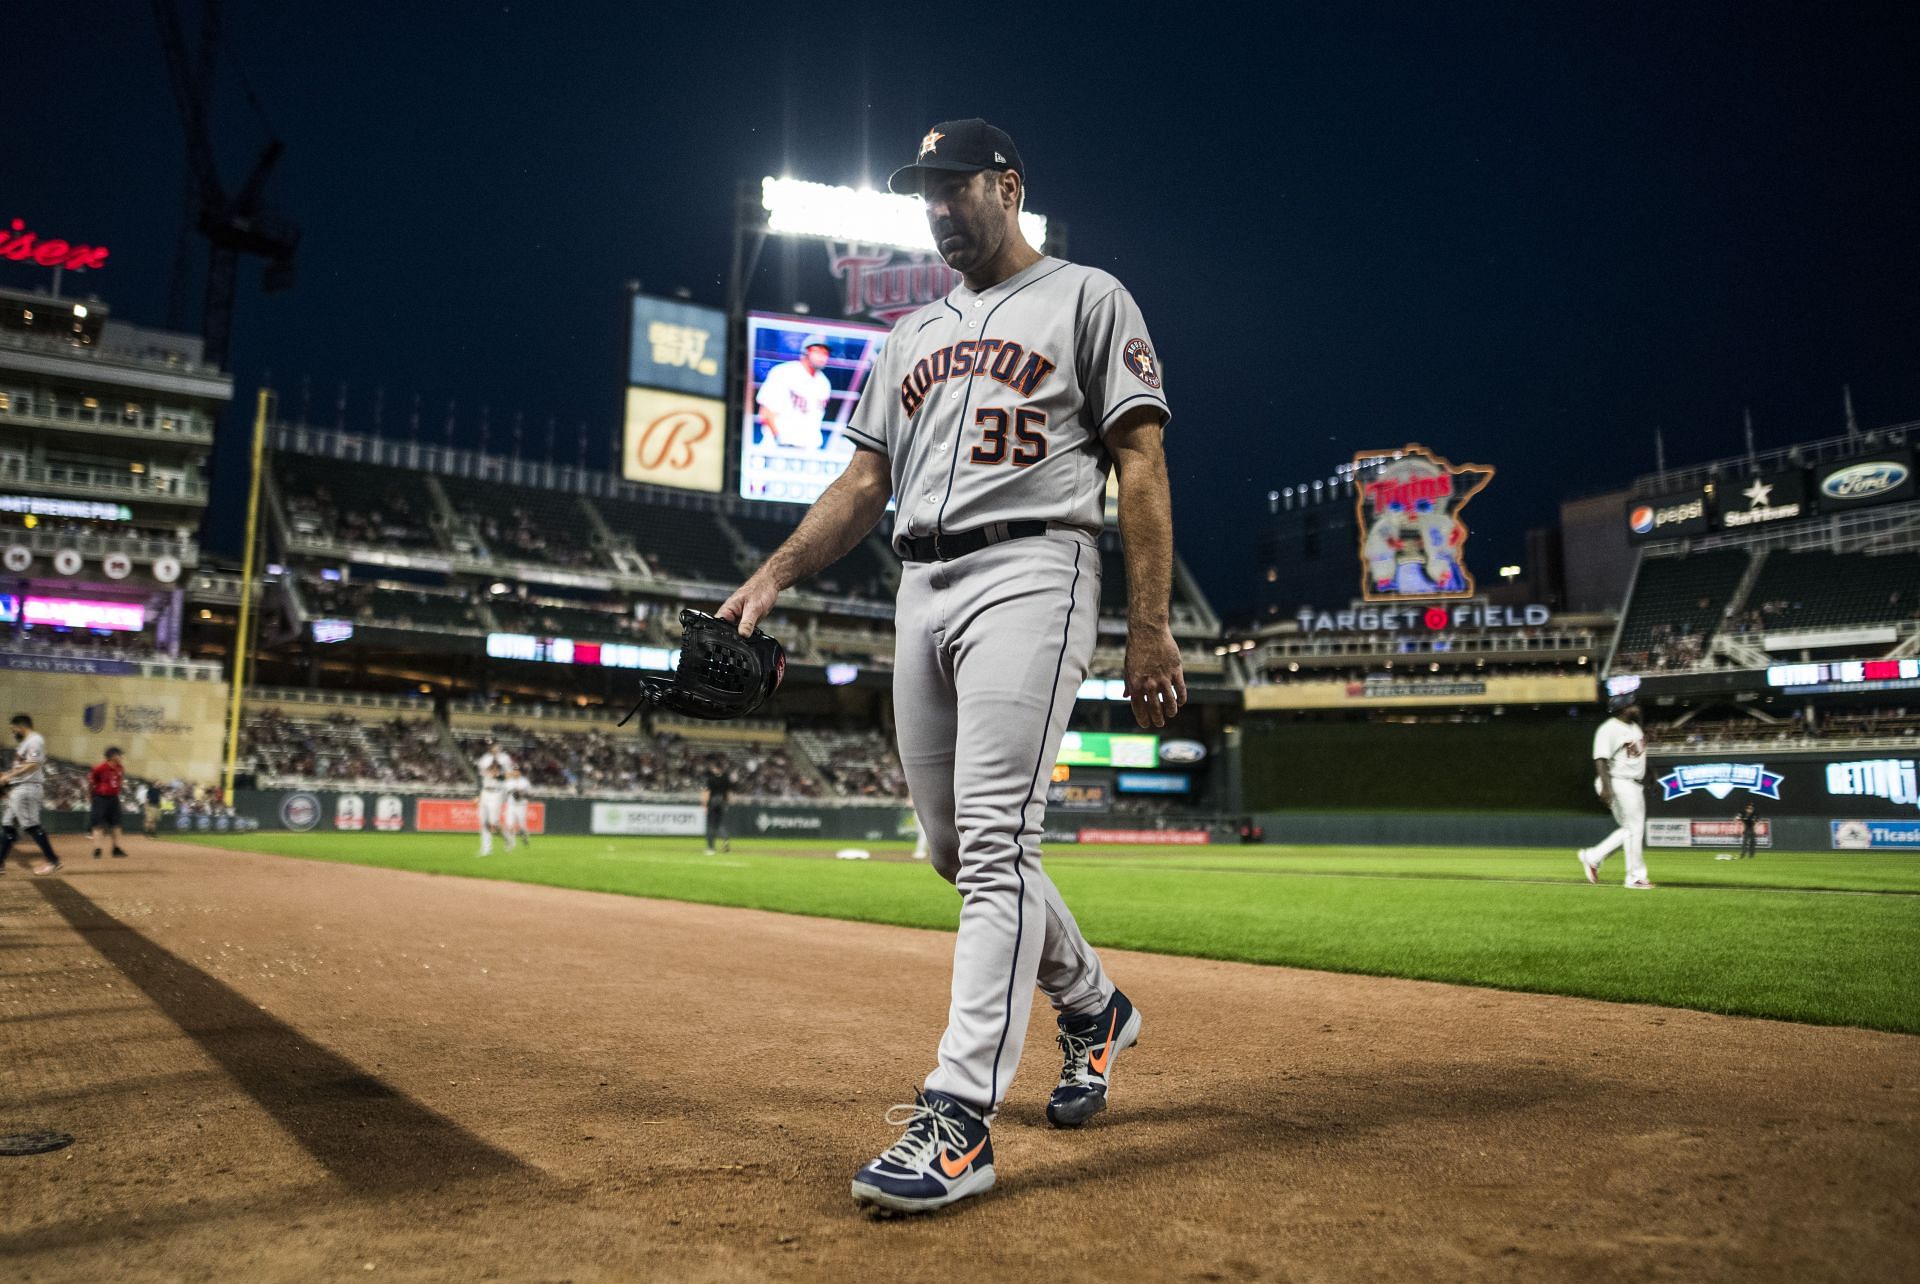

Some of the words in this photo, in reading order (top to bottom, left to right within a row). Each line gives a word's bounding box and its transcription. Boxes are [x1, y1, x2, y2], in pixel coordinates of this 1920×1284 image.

[901, 339, 1057, 420] HOUSTON
[970, 407, 1048, 466] 35
[1365, 474, 1453, 514] Twins
[1838, 471, 1890, 494] Ford
[1655, 499, 1704, 528] pepsi
[1297, 610, 1420, 631] TARGET
[1453, 605, 1549, 628] FIELD
